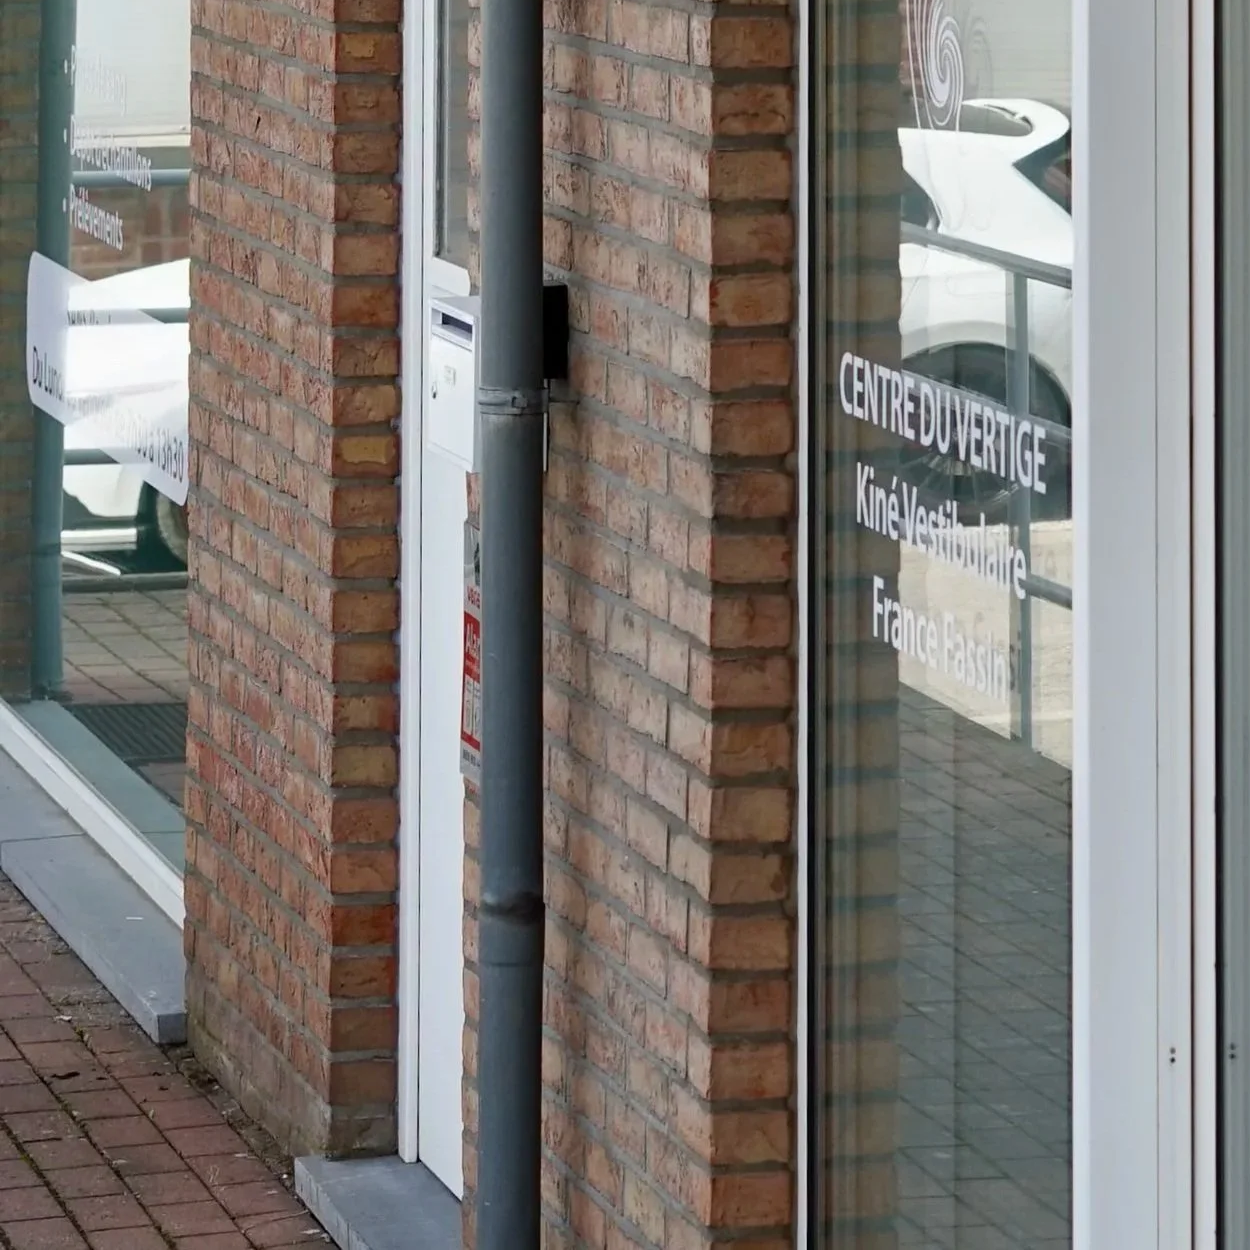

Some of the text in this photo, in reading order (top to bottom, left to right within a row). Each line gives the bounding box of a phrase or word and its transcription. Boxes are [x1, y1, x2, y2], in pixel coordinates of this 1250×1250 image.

[69, 183, 124, 251] Prélèvements
[33, 345, 43, 388] Du
[839, 351, 1047, 495] CENTRE DU VERTIGE
[856, 461, 1027, 600] Kiné Vestibulaire
[872, 575, 939, 670] France
